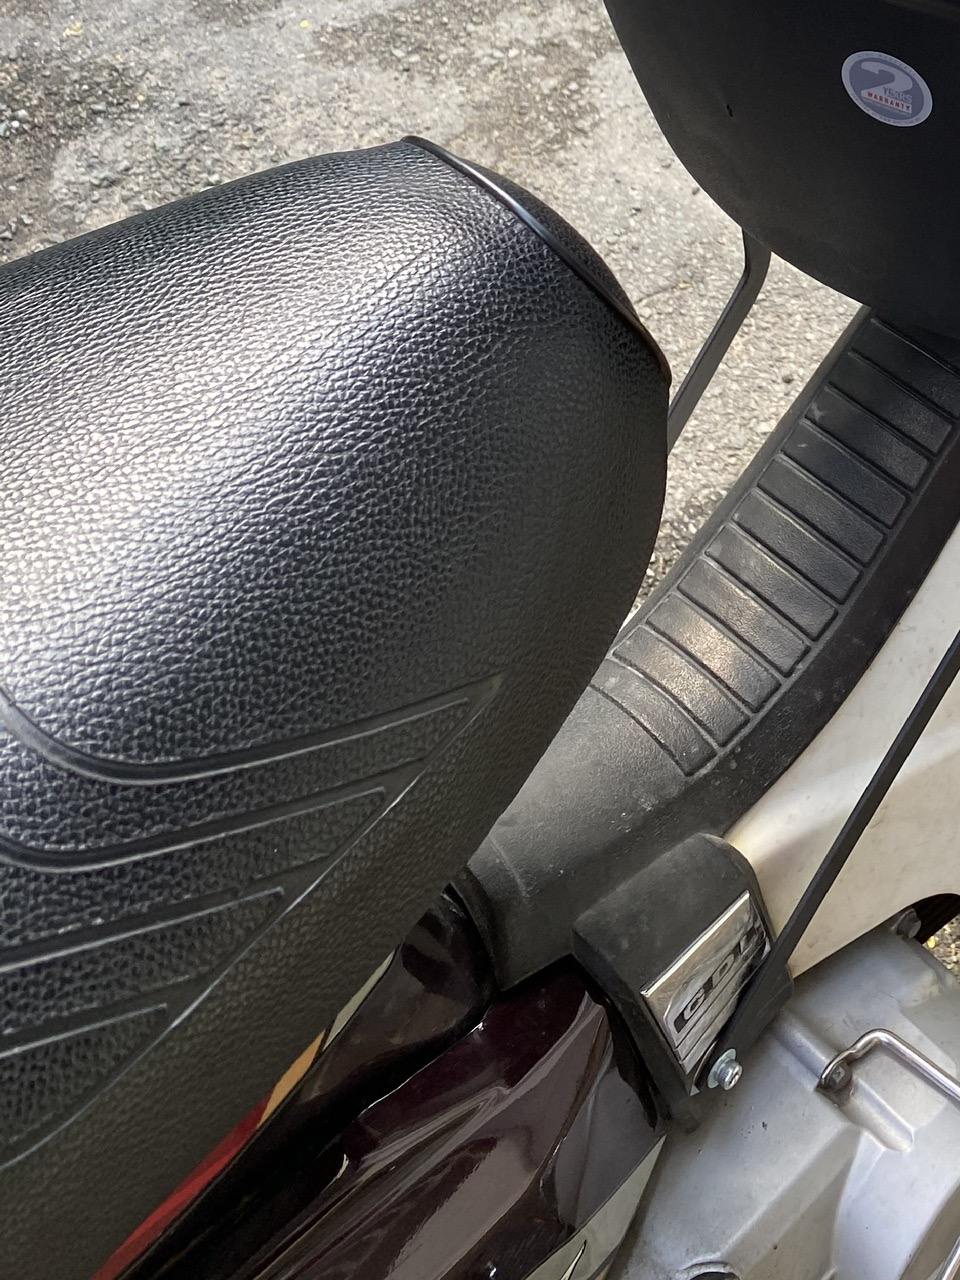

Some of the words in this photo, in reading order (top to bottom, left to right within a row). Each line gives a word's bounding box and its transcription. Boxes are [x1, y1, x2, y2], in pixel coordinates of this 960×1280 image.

[860, 61, 913, 114] 2
[882, 86, 913, 103] YEARS
[866, 91, 912, 111] WARRANTY
